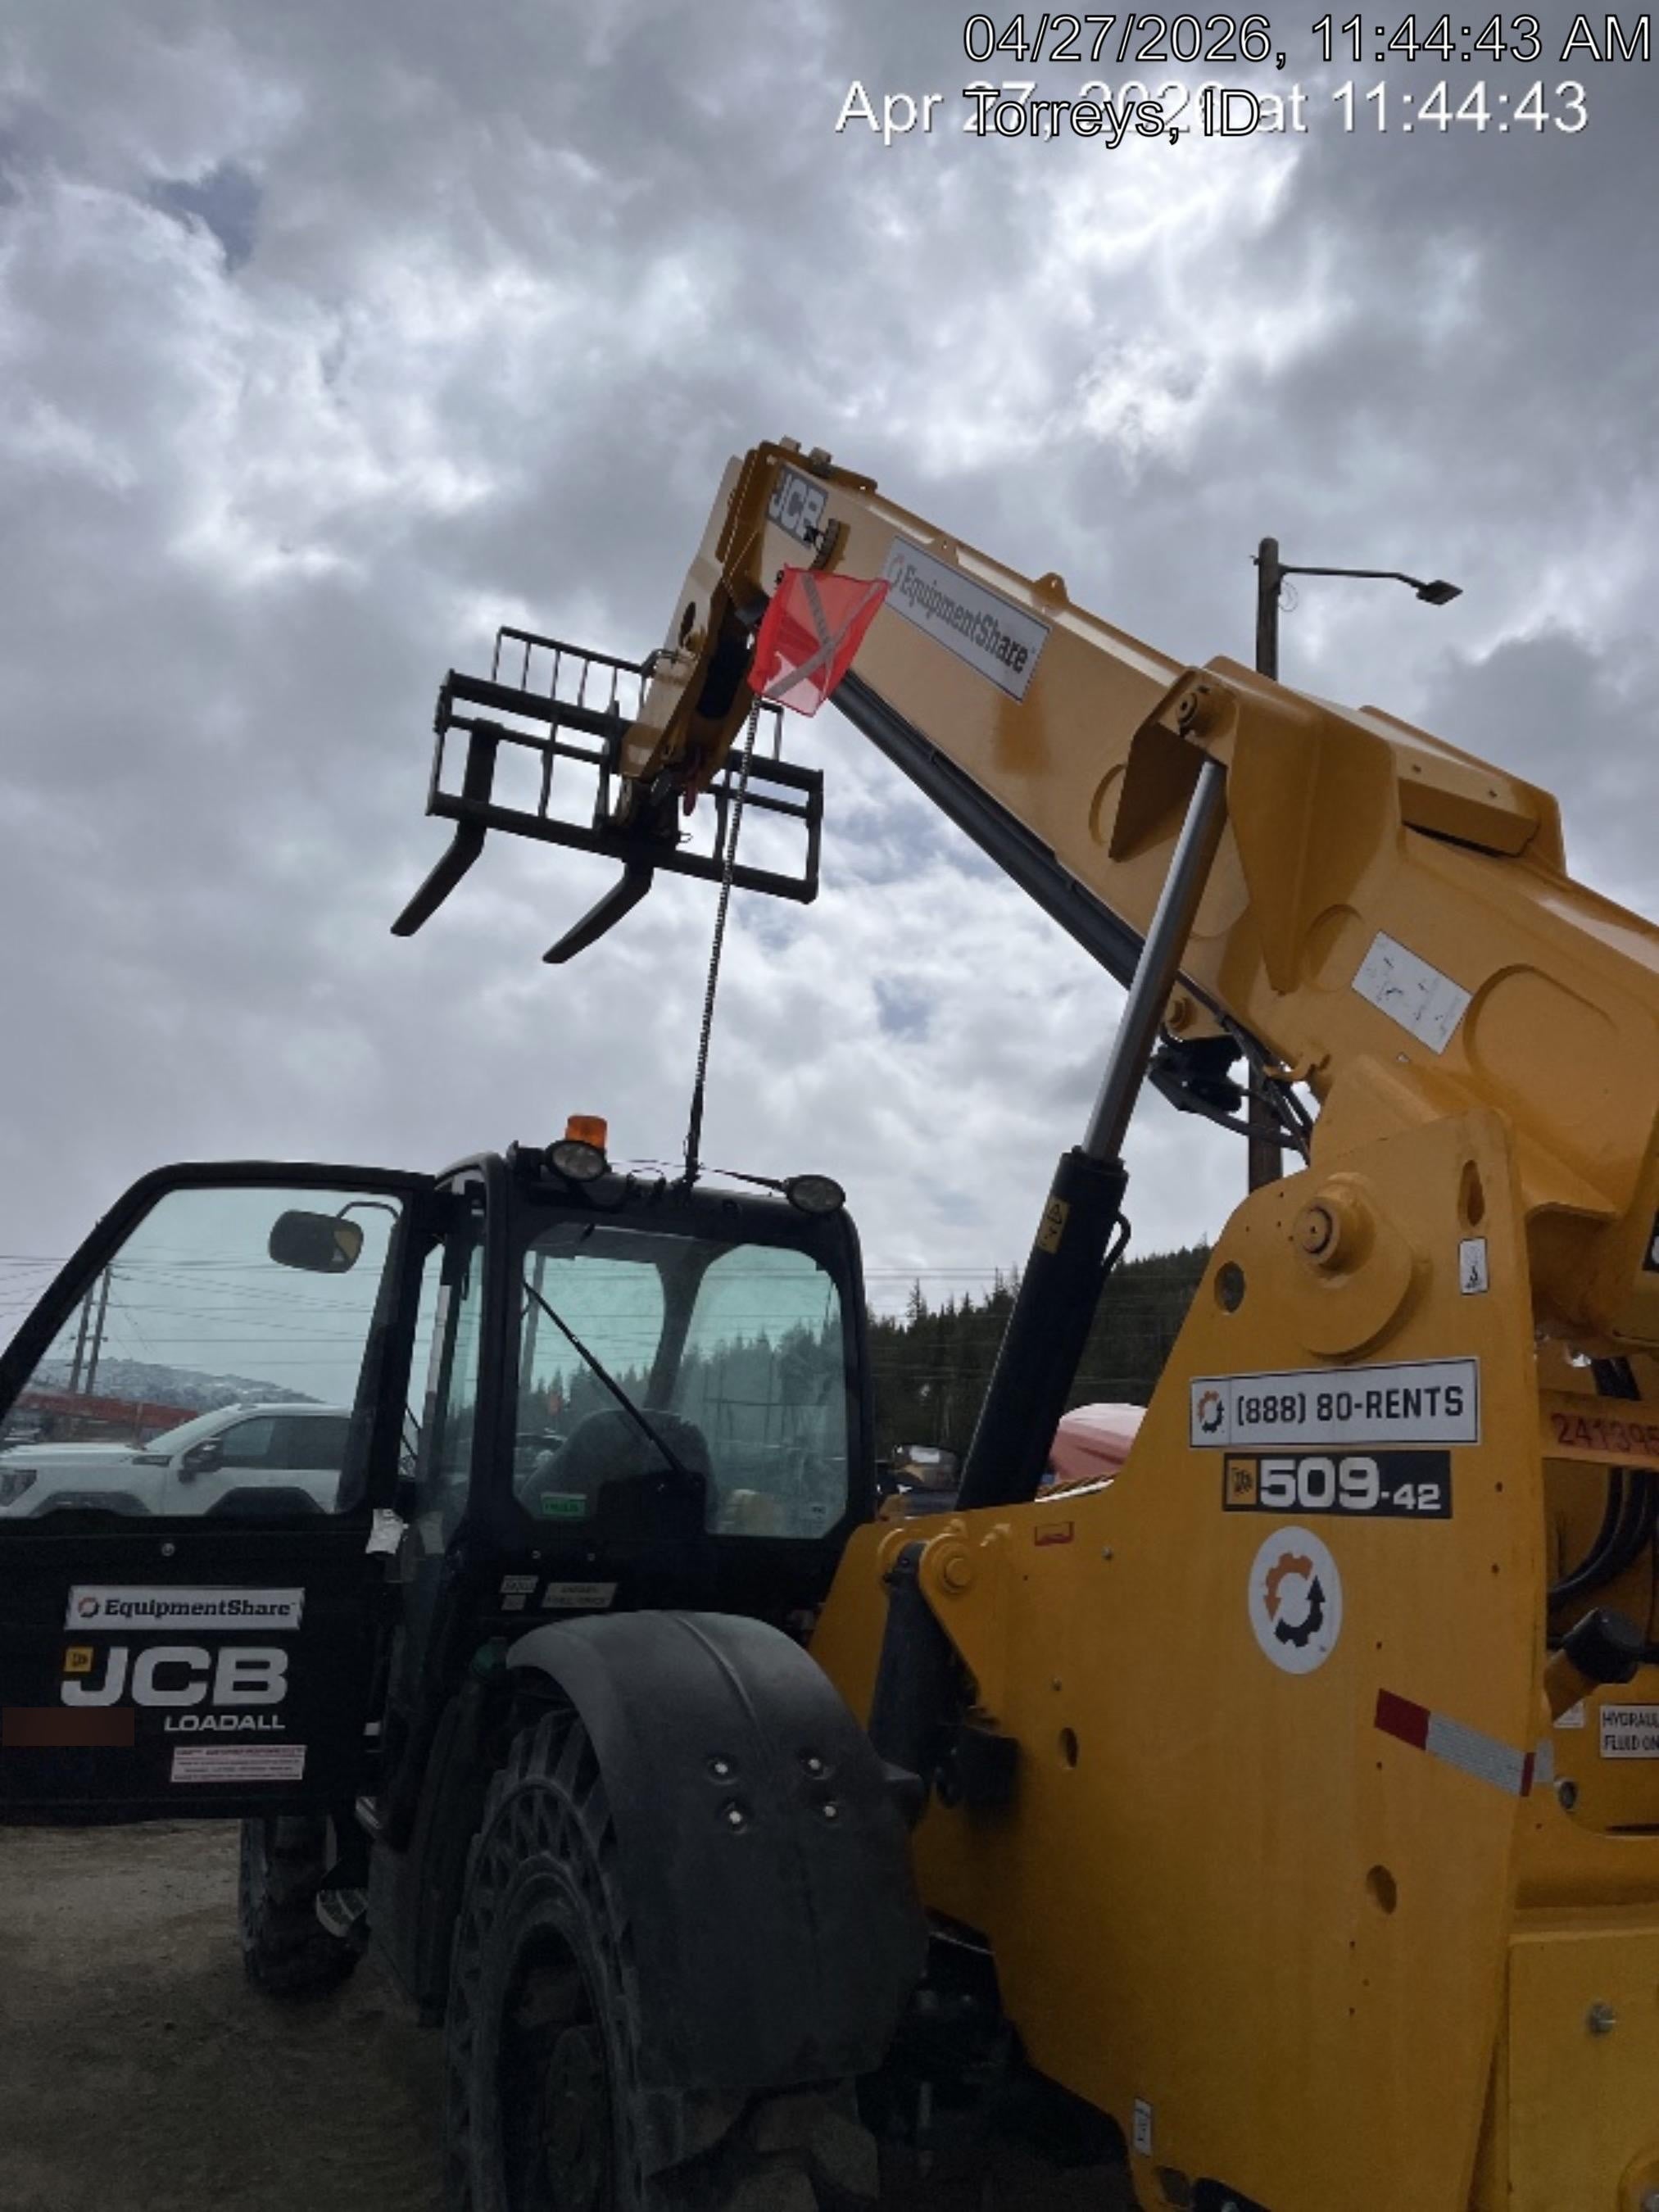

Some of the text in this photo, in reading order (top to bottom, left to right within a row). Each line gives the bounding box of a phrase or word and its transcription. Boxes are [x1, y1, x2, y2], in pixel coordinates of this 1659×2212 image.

[768, 473, 825, 541] JCB
[900, 565, 1029, 674] EquipmentShare
[1236, 1385, 1464, 1425] (888) 80-RENTS
[104, 1598, 291, 1617] EquipmentShare
[60, 1646, 288, 1706] JCB
[163, 1715, 287, 1732] LOADALL
